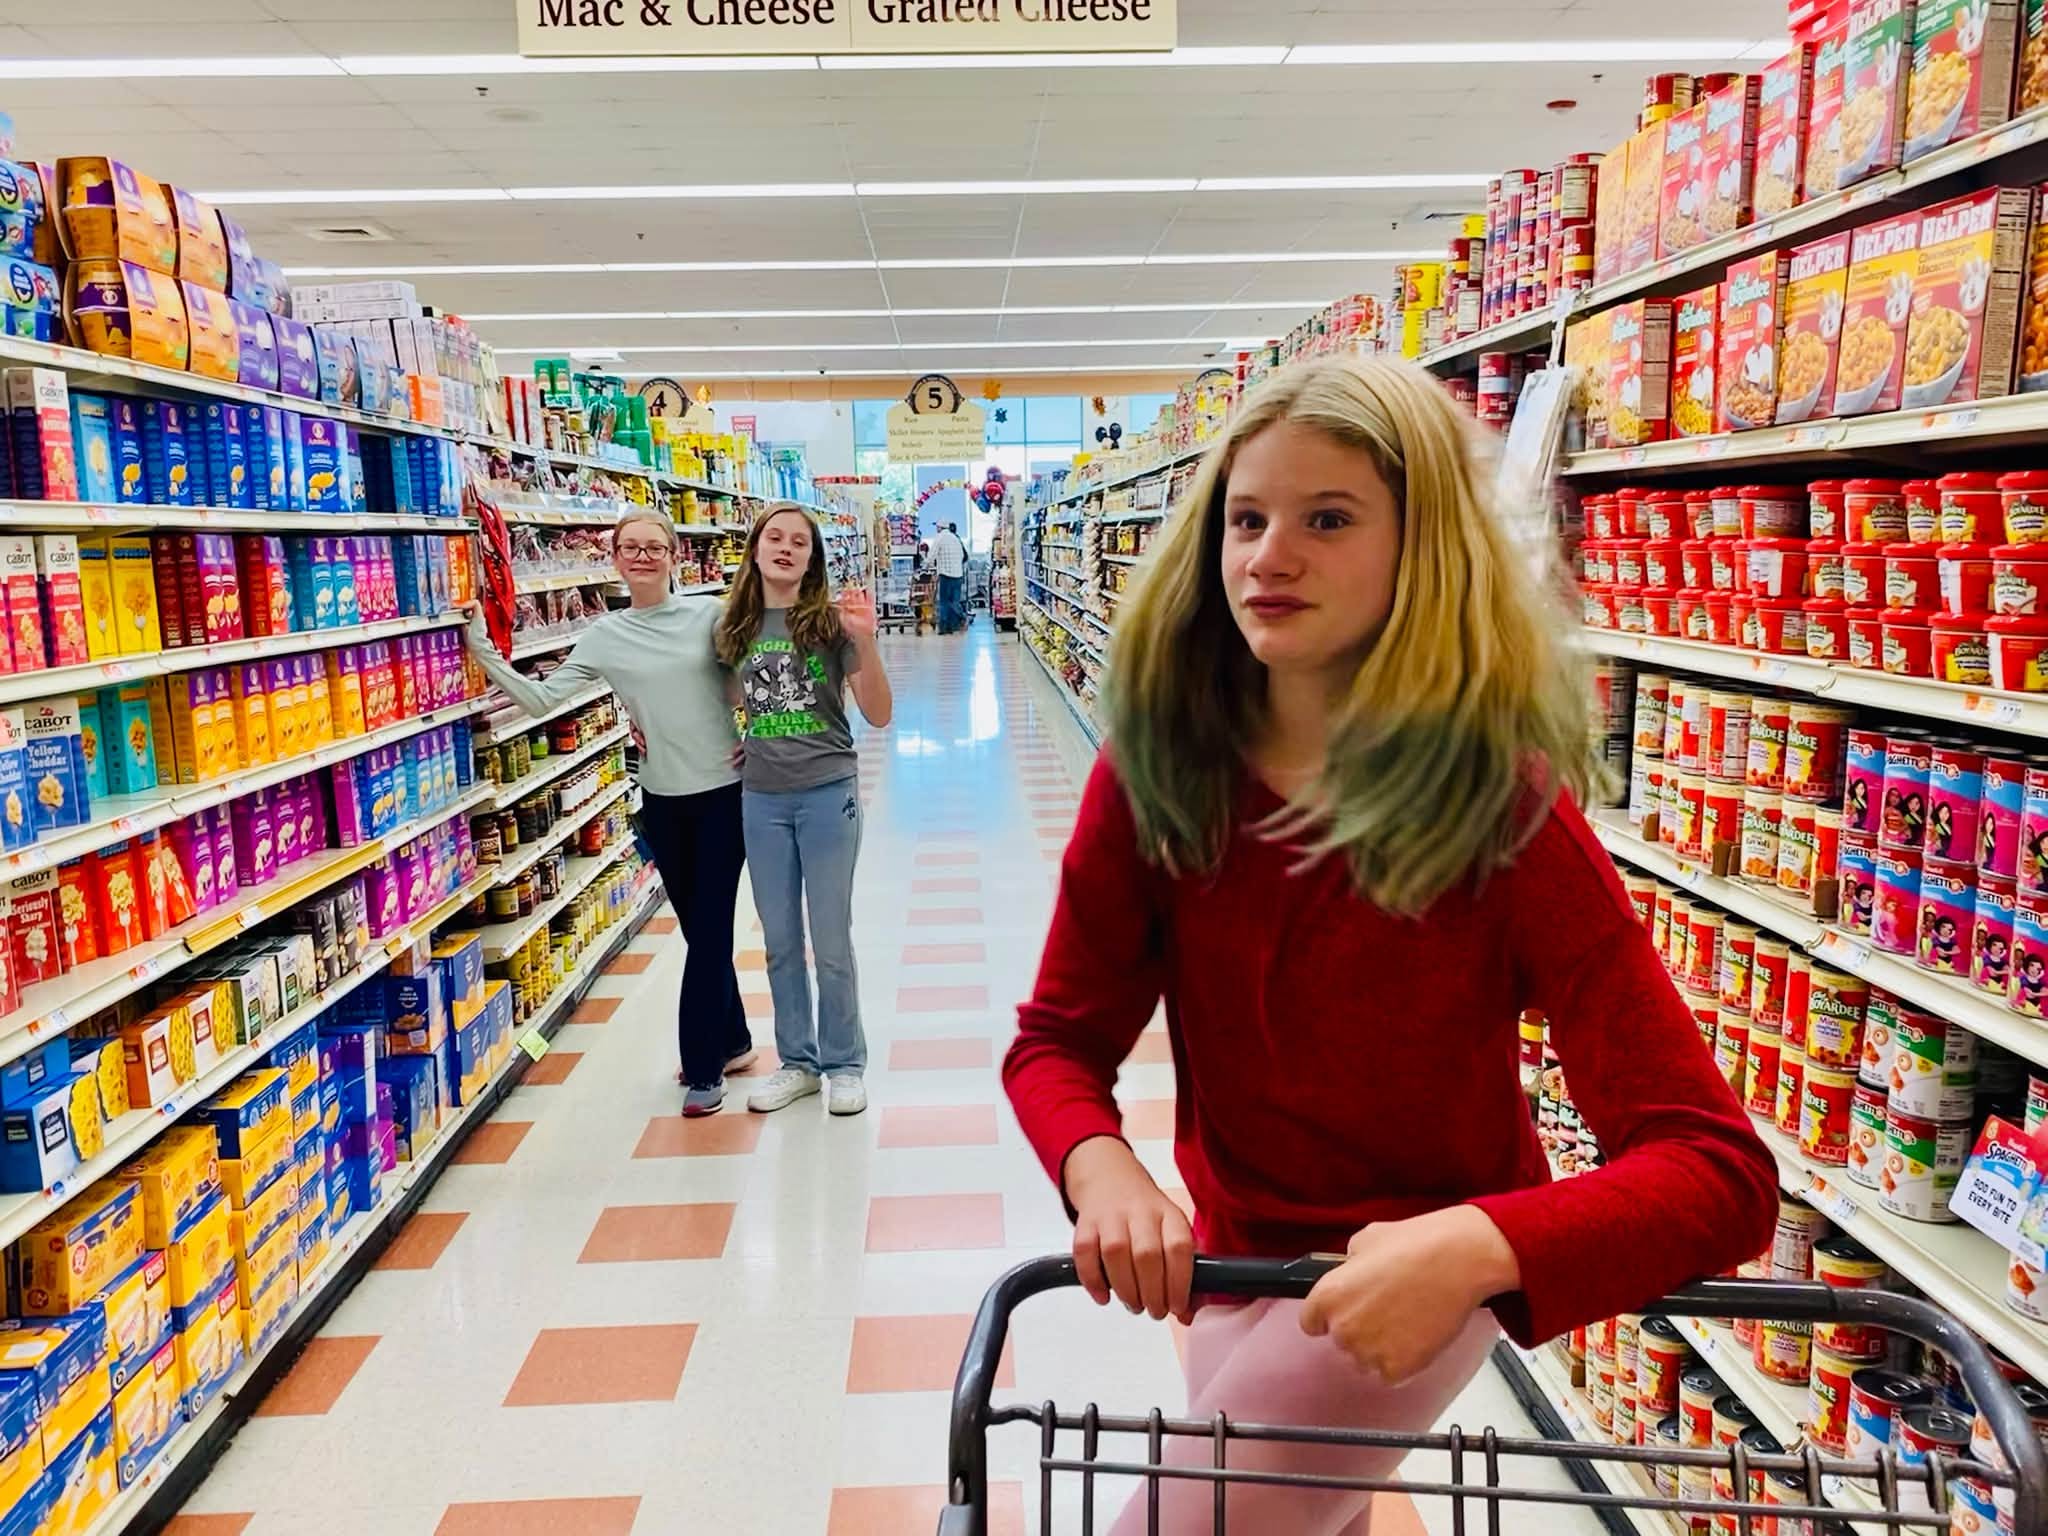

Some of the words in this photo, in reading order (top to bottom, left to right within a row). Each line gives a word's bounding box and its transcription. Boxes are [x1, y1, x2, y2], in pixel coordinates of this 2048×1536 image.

[537, 0, 624, 27] Mac
[640, 0, 672, 27] &
[687, 0, 835, 26] Cheese
[868, 0, 1000, 24] Grated
[1015, 0, 1151, 23] Cheese
[1921, 199, 1997, 248] HELPER
[1853, 223, 1917, 262] HELPER
[1790, 245, 1845, 281] HELPER
[650, 391, 667, 409] 4
[928, 387, 943, 409] 5
[25, 716, 72, 730] CABOT
[28, 744, 63, 758] Yellow
[29, 756, 67, 769] heddar
[11, 871, 51, 889] CABOT
[11, 897, 49, 915] Seriously
[1974, 1178, 1989, 1194] ADD
[1990, 1188, 2006, 1205] FUN
[2007, 1197, 2018, 1212] TO
[1968, 1190, 1993, 1212] EVERY
[1992, 1206, 2012, 1225] BITE
